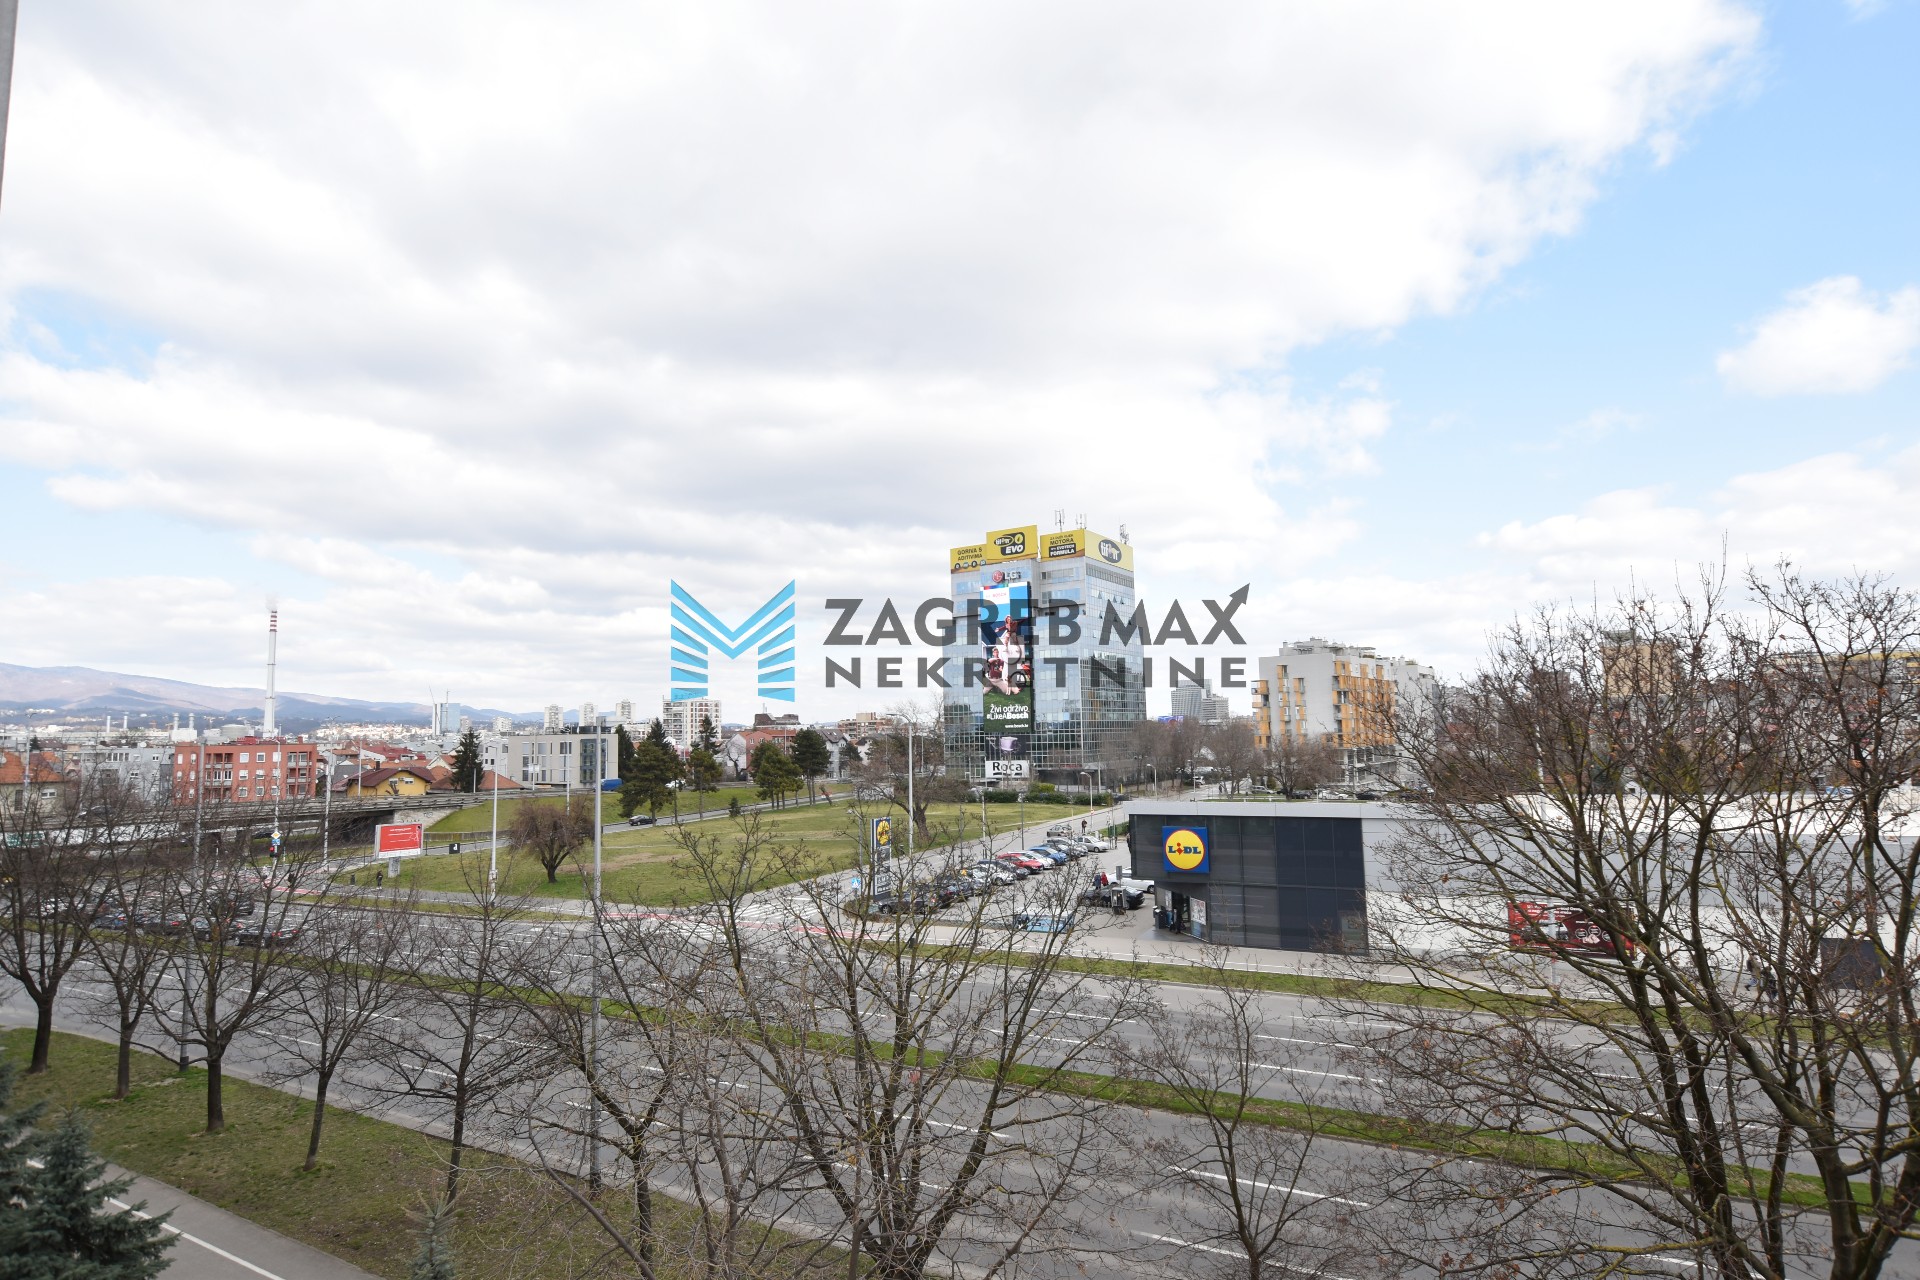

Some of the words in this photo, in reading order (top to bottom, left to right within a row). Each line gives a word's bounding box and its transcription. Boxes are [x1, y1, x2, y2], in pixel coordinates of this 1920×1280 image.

[1005, 544, 1024, 554] EVO
[1050, 549, 1075, 557] FORMULA
[1004, 570, 1017, 580] LG
[990, 703, 1002, 713] Živi
[992, 761, 1023, 772] Roca
